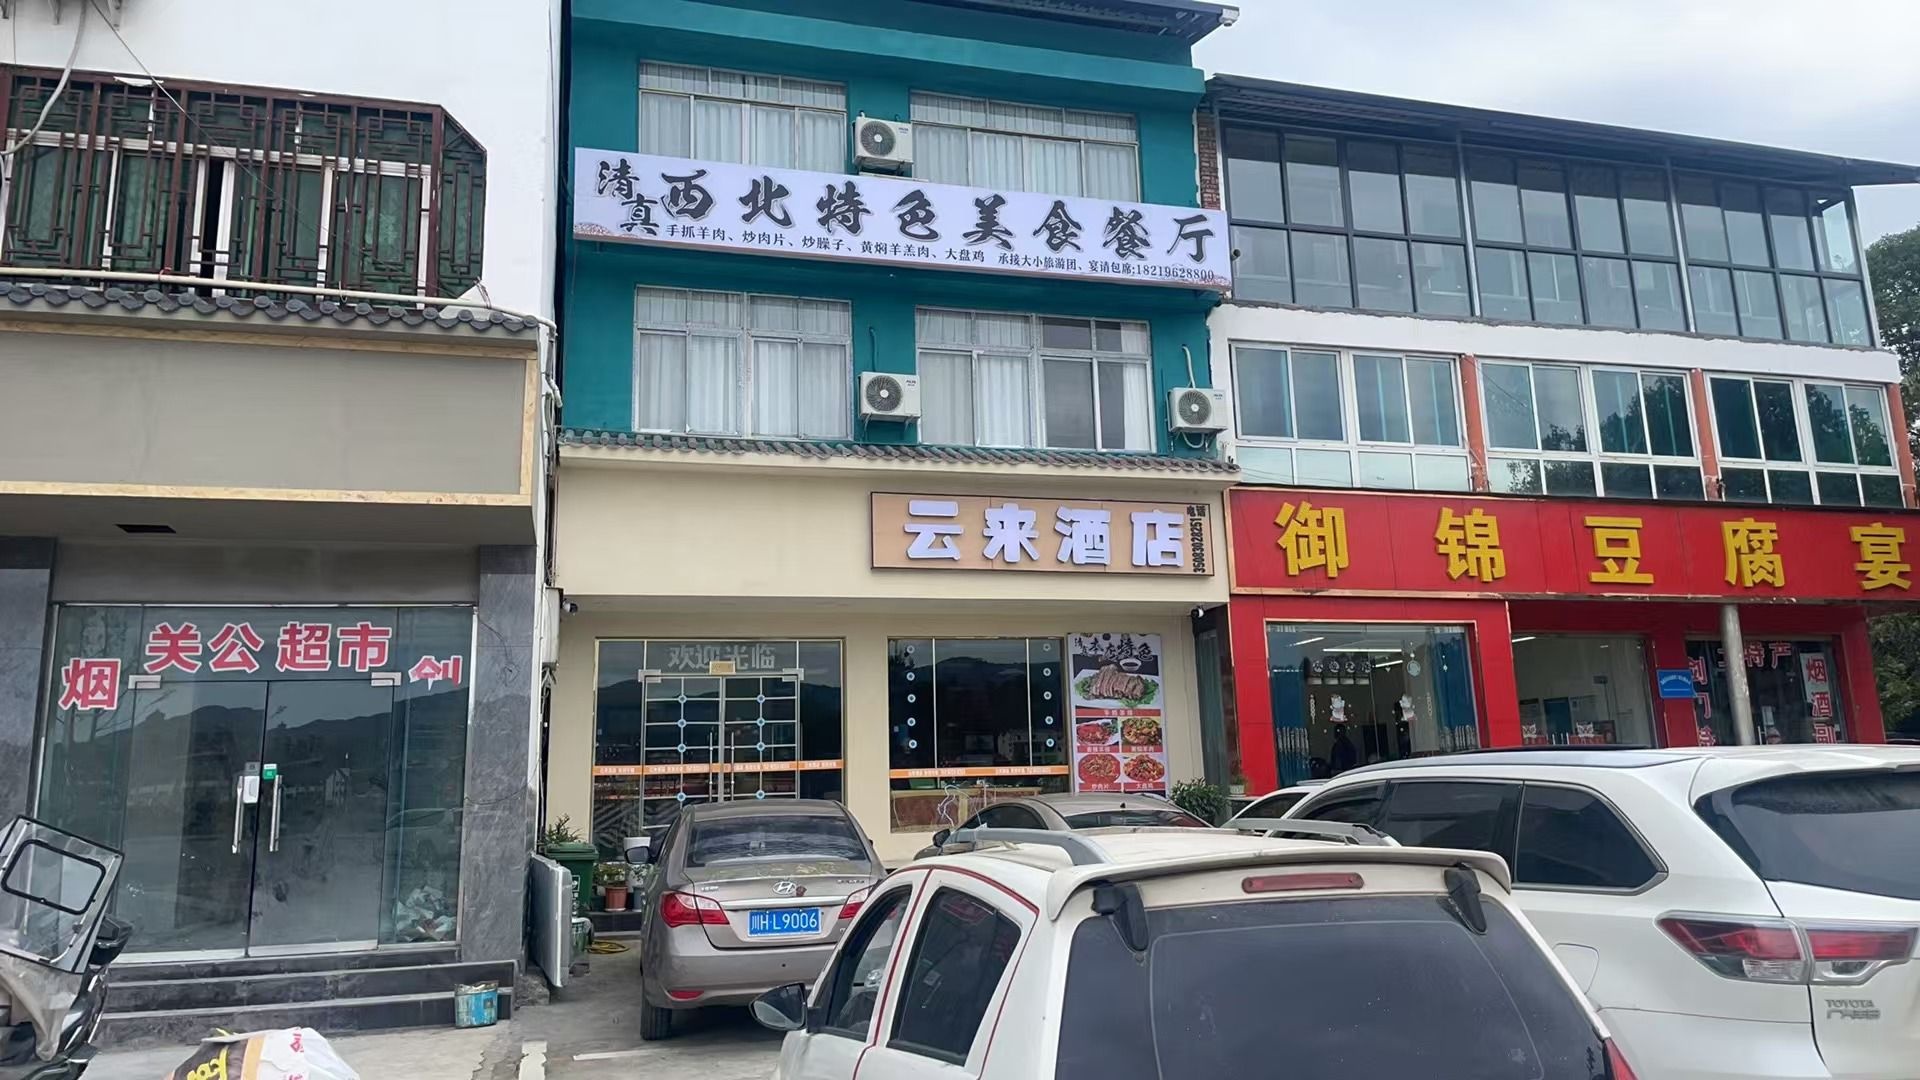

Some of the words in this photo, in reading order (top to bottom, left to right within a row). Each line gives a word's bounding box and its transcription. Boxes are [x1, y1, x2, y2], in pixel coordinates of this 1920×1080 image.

[598, 158, 659, 236] 清真
[660, 168, 1214, 263] 西北特色美食餐厅
[903, 499, 1185, 567] 云来酒店
[1273, 500, 1912, 591] 御锦豆腐宴
[144, 621, 393, 674] 关公超市
[667, 643, 776, 670] 欢迎光临
[58, 657, 122, 711] 烟
[1824, 999, 1875, 1008] TOYOTA
